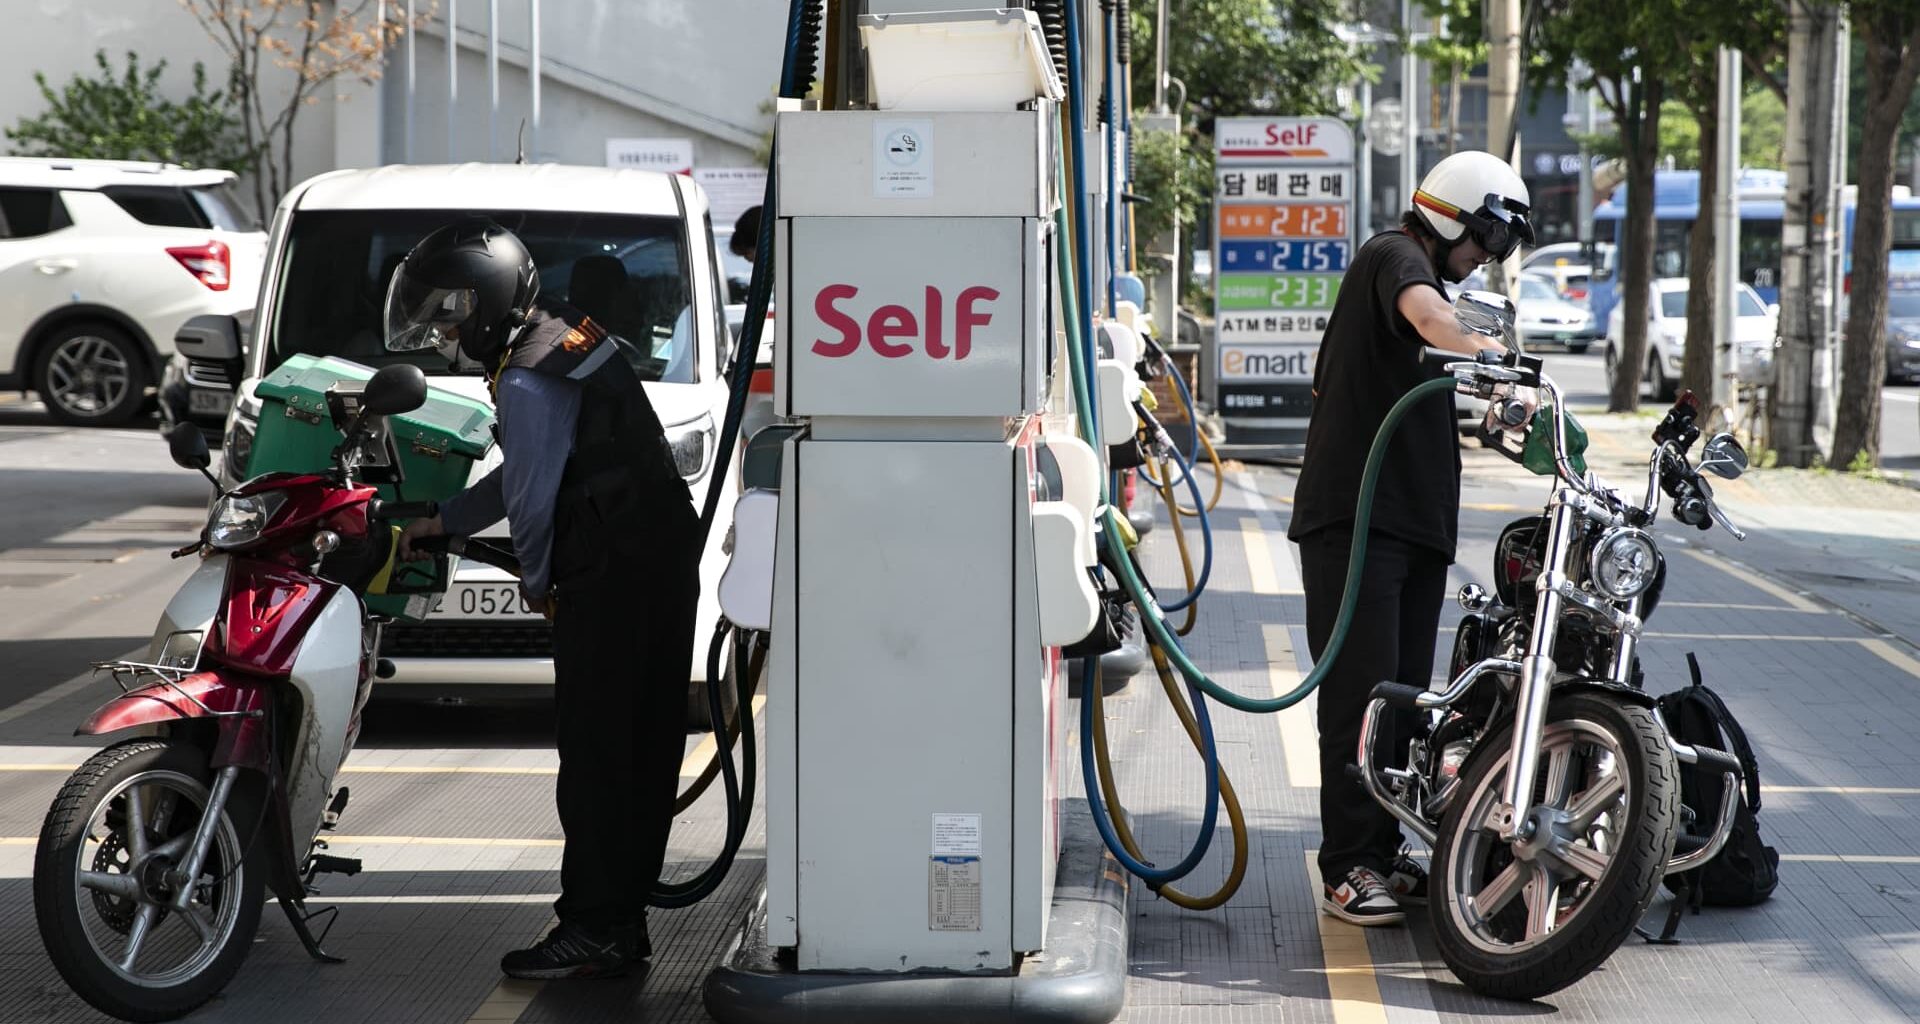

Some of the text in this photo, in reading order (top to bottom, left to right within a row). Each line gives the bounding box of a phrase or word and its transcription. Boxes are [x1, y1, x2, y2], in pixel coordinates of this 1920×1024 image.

[1265, 123, 1318, 146] Self
[1270, 206, 1344, 235] 2127
[1272, 242, 1348, 270] 2157
[1271, 278, 1343, 306] 233
[811, 284, 1000, 360] Self
[1222, 318, 1259, 332] ATM
[1224, 349, 1307, 375] emart
